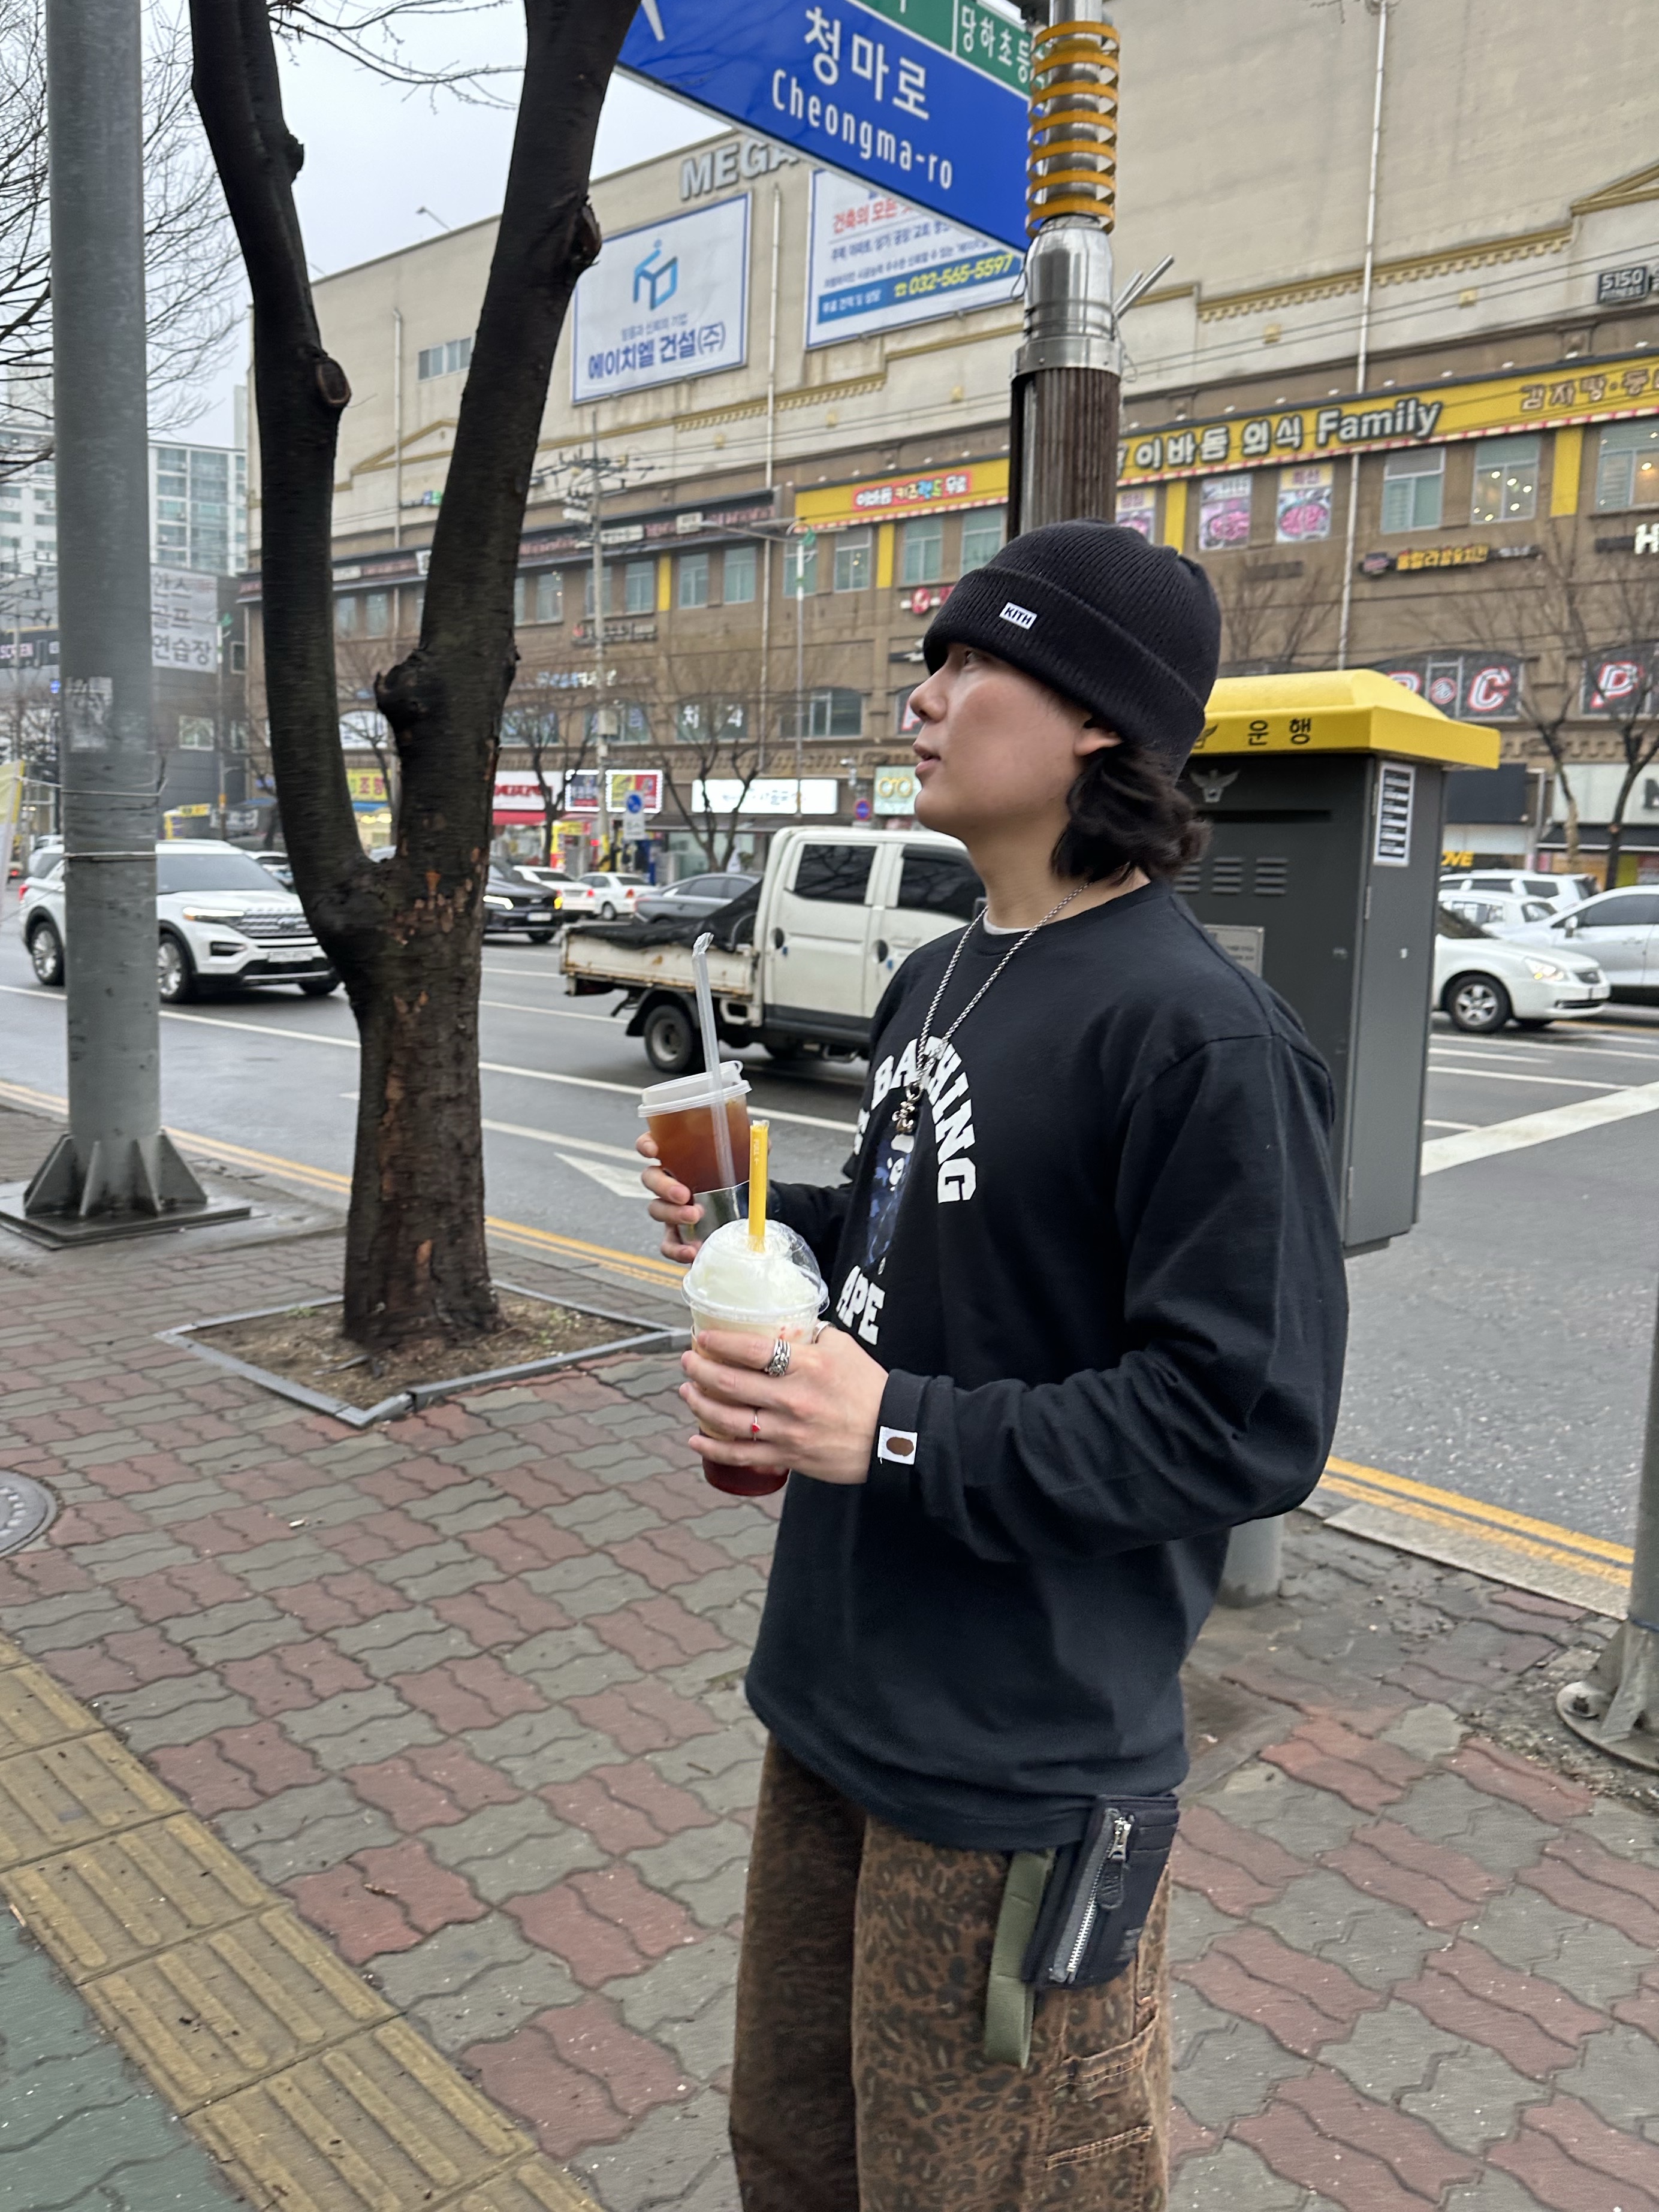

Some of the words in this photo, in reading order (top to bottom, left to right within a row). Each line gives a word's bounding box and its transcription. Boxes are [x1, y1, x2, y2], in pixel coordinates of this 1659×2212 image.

[804, 7, 929, 120] 청마로
[773, 69, 952, 189] Cheongma-ro
[588, 339, 654, 379] 에이치엘
[660, 321, 726, 363] 건설(주)
[1136, 425, 1229, 470] 이바돔
[1242, 414, 1304, 455] 외식
[1317, 399, 1442, 447] Family
[153, 635, 212, 665] 연습장
[1004, 606, 1033, 625] KITH
[871, 1036, 976, 1203] BATHING
[835, 1265, 885, 1345] APE
